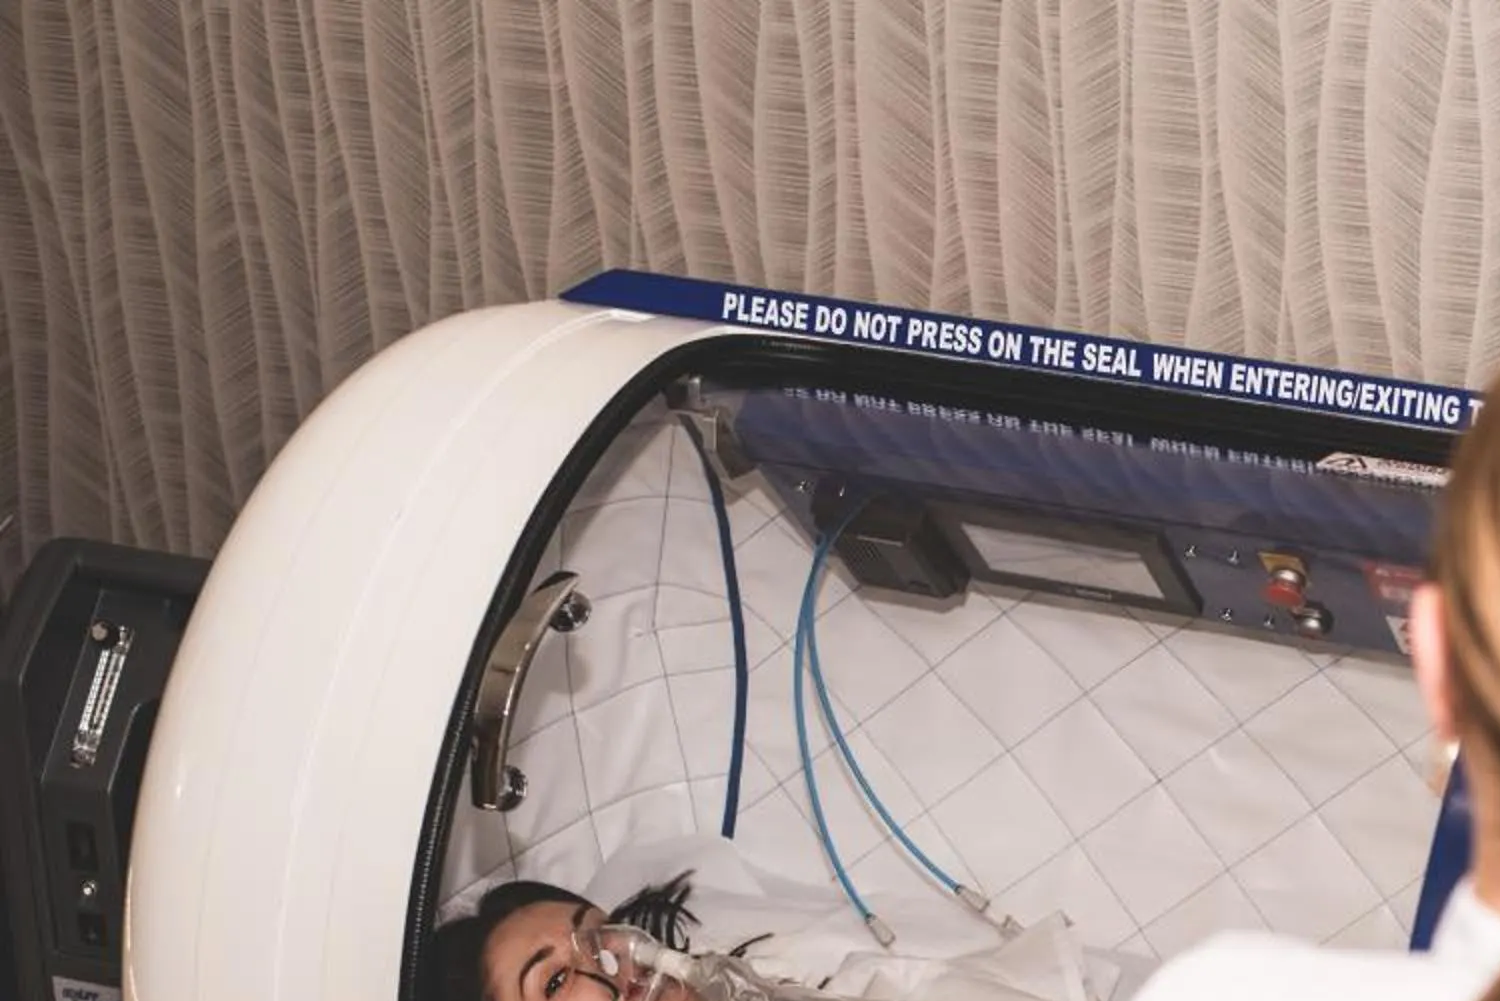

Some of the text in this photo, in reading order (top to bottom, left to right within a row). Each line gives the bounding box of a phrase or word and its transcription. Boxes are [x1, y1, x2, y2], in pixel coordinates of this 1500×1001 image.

[722, 291, 809, 331] PLEASE
[814, 304, 848, 336] DO
[853, 309, 902, 343] NOT
[907, 317, 983, 355] PRESS
[987, 329, 1023, 361] ON
[1029, 334, 1077, 369] THE
[1081, 343, 1143, 378] SEAL
[1153, 352, 1223, 390] WHEN
[1229, 362, 1461, 426] ENTERING/EXITING
